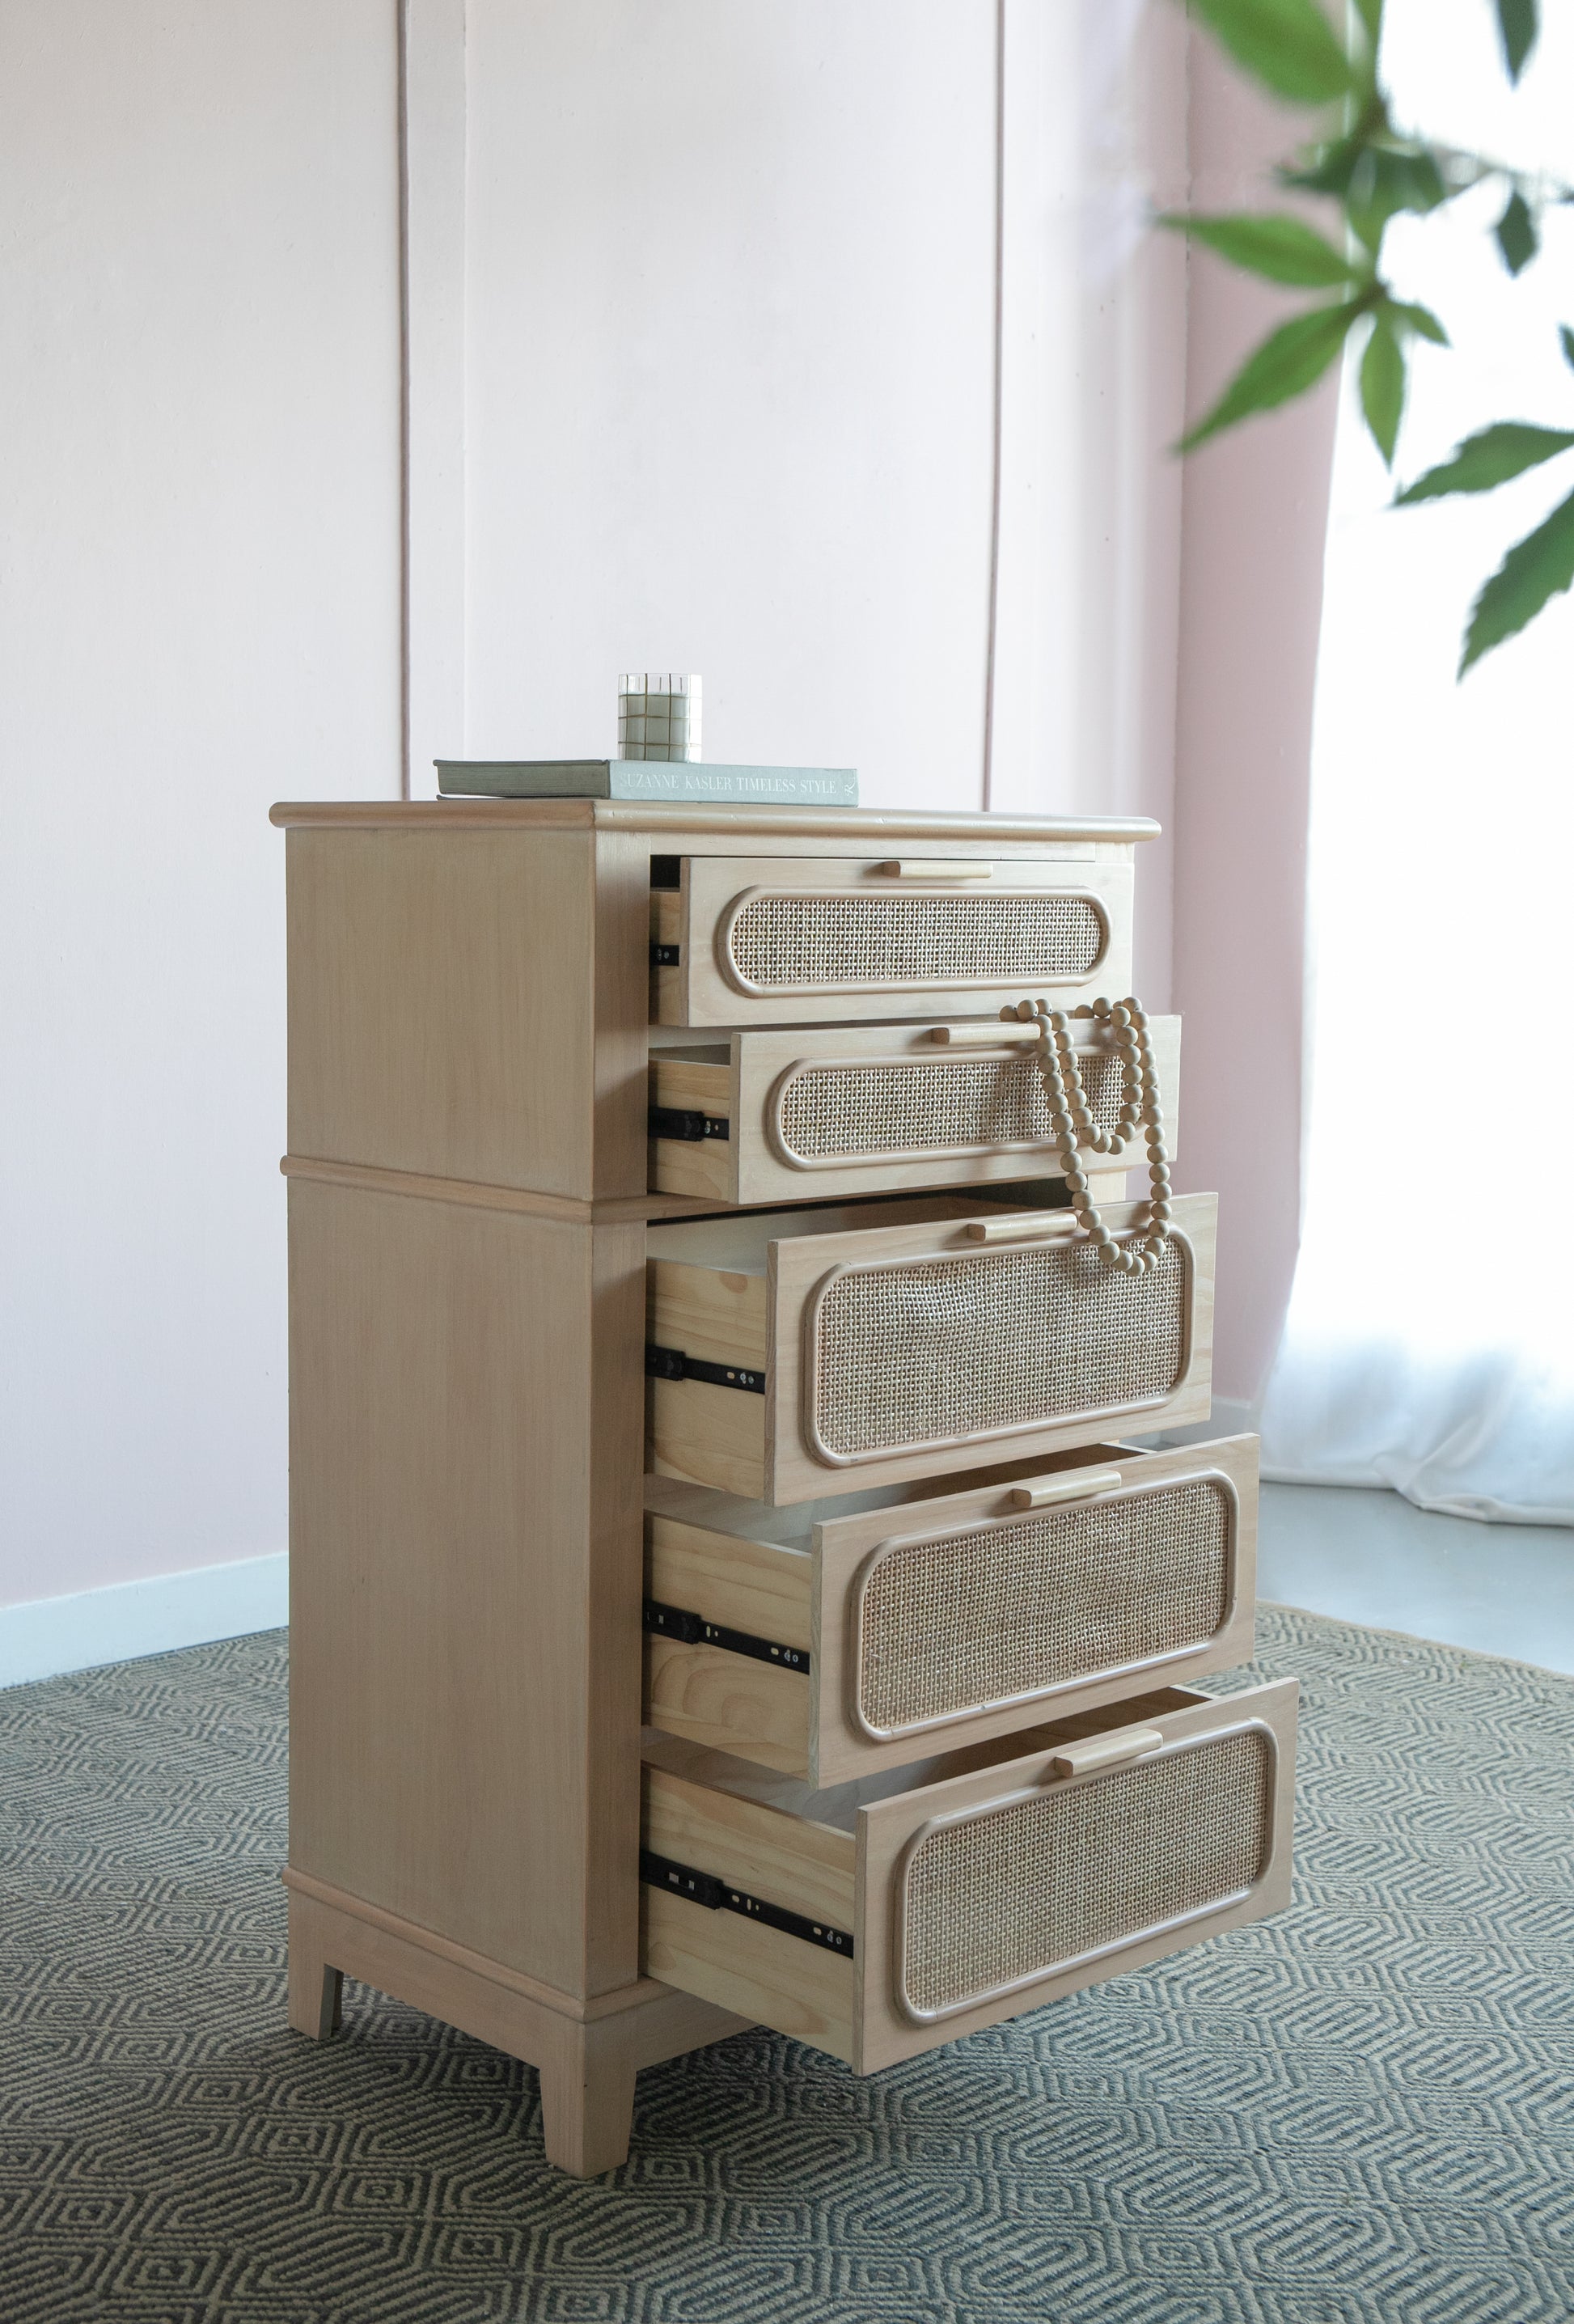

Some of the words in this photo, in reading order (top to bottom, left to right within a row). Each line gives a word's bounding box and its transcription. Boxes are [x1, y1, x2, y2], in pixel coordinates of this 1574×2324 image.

[620, 773, 679, 789] SUZANNE
[685, 775, 732, 791] KASLER
[738, 777, 796, 792] TIMELESS
[800, 779, 836, 794] STYLE
